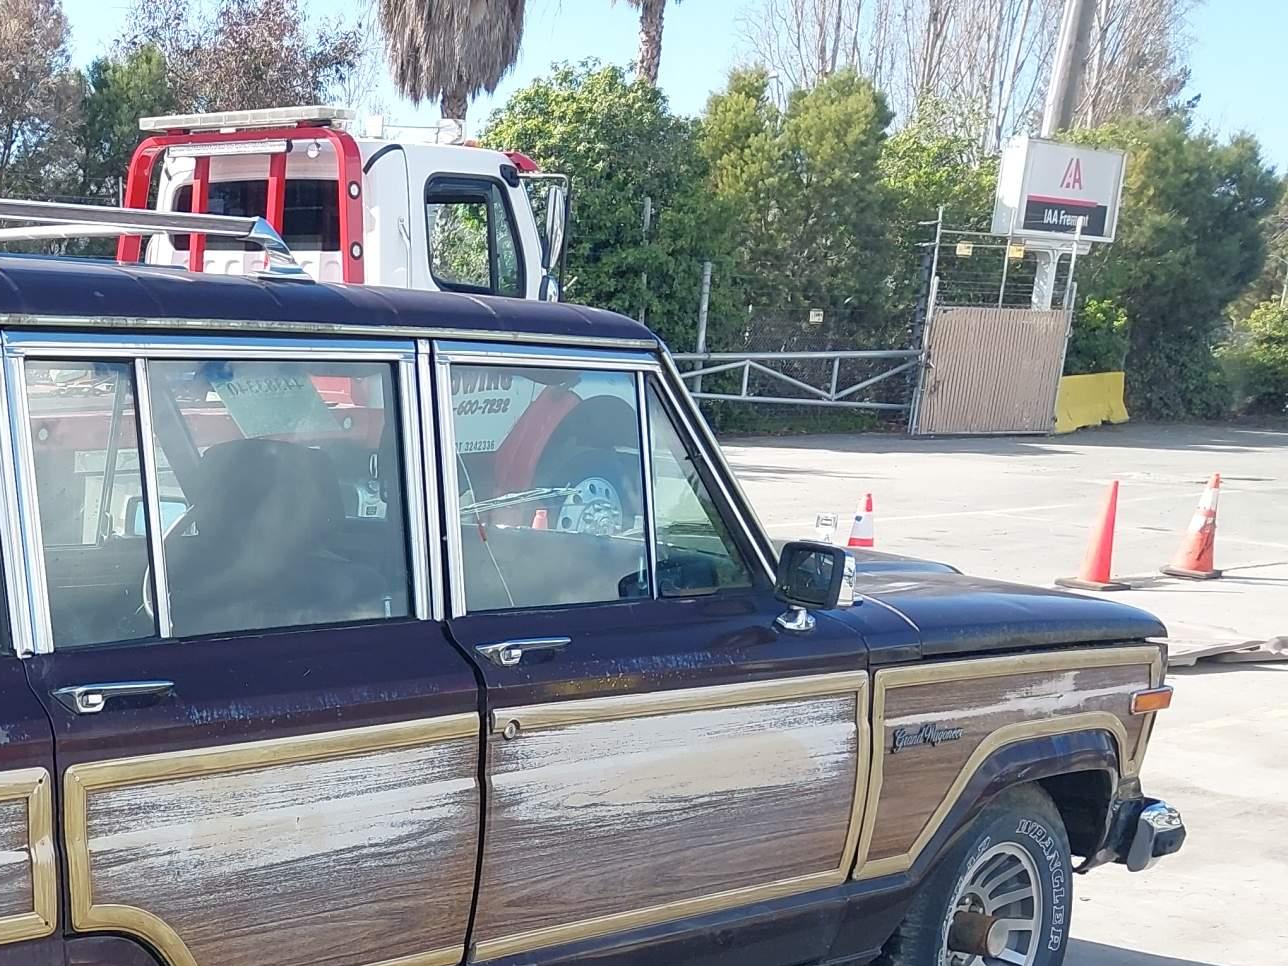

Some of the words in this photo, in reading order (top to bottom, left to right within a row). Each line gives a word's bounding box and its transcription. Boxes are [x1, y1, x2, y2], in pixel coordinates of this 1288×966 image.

[1043, 208, 1059, 225] IAA
[1059, 209, 1089, 228] Fremnt
[1015, 818, 1067, 951] WRANGLER
